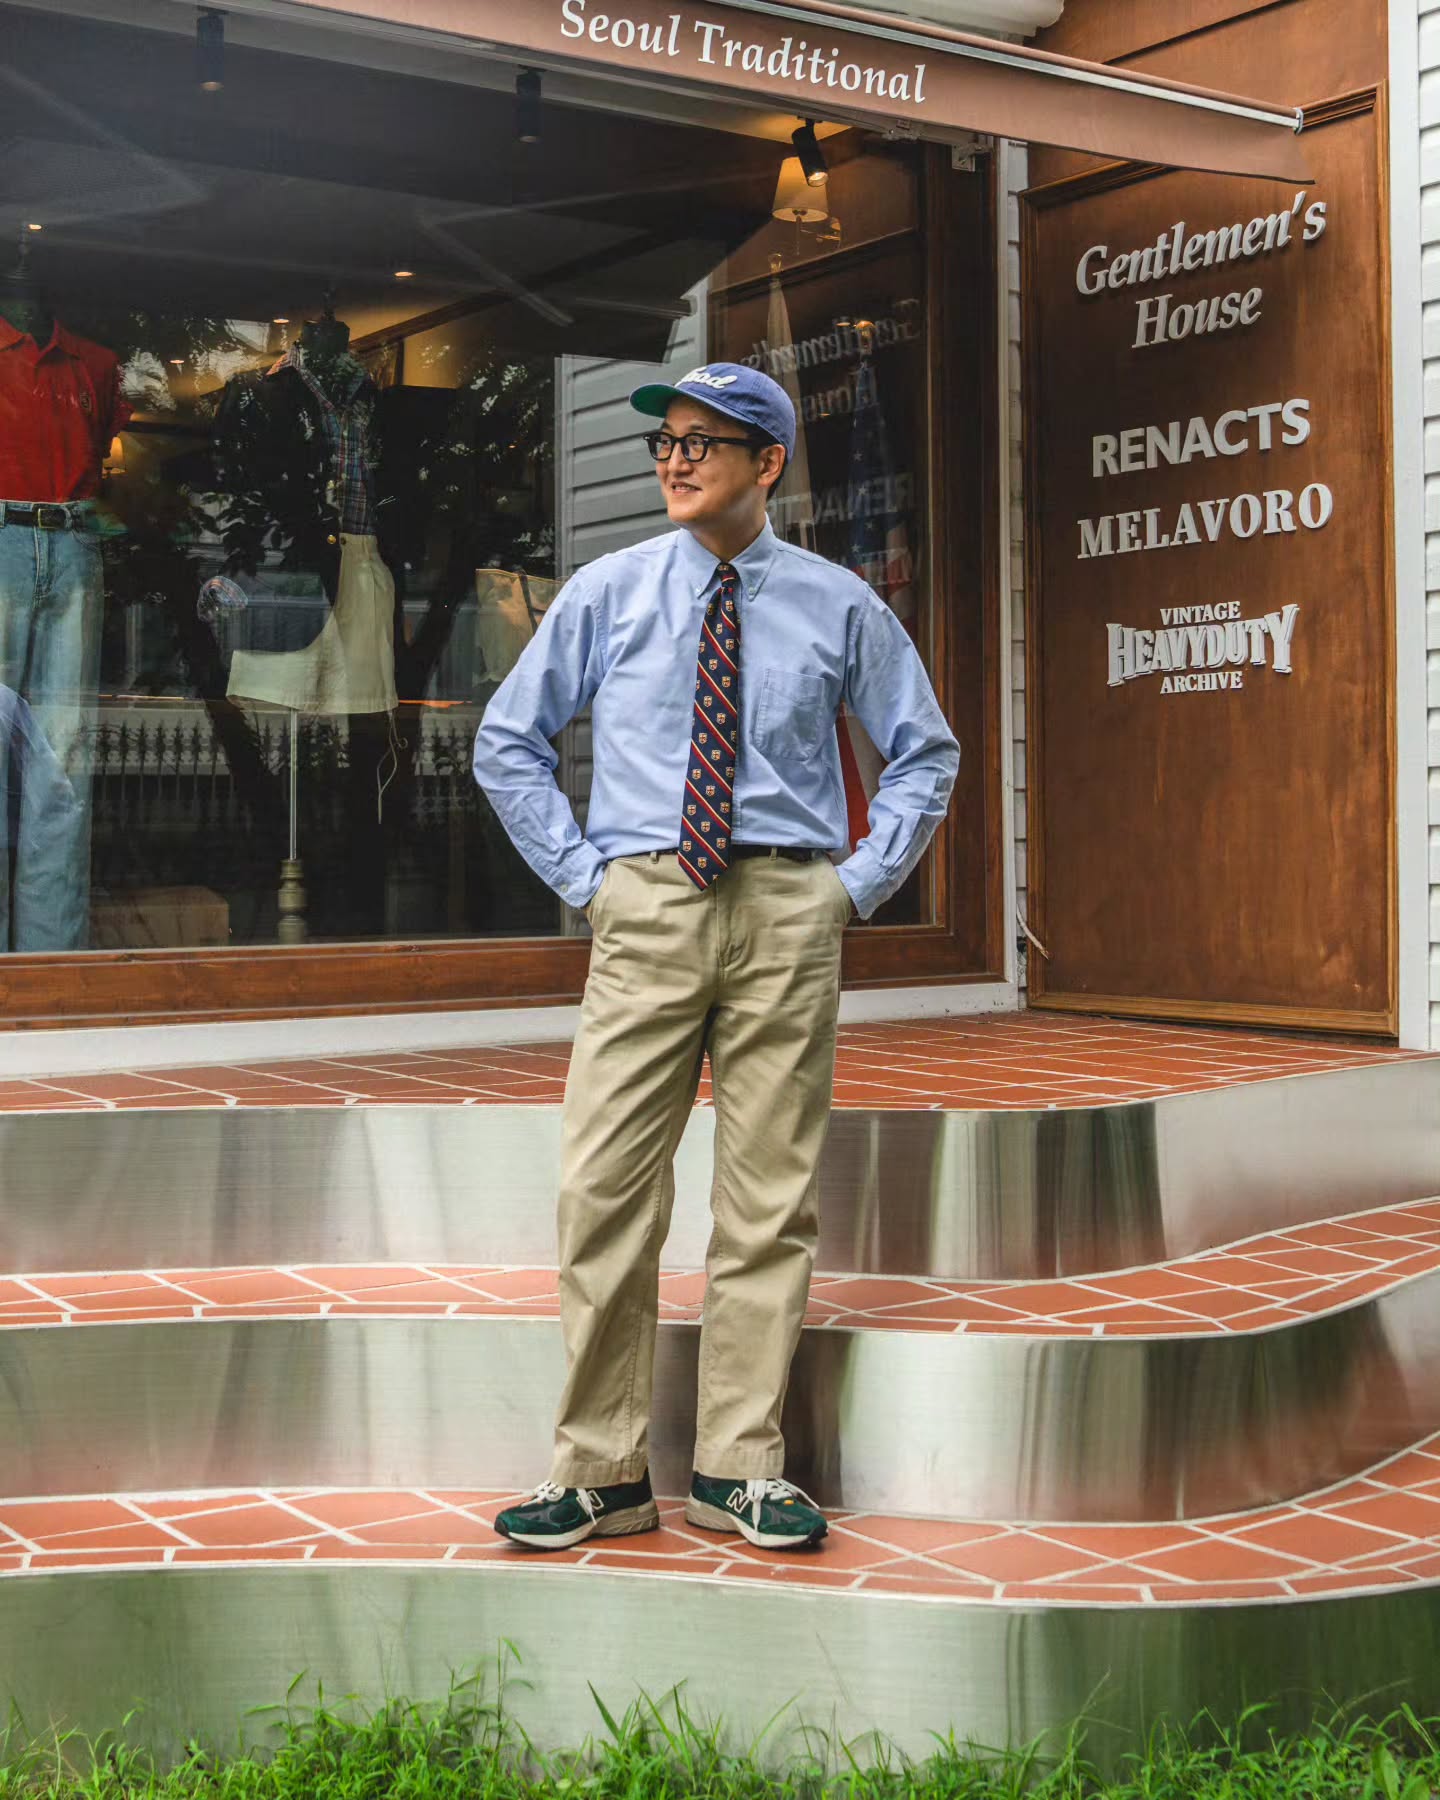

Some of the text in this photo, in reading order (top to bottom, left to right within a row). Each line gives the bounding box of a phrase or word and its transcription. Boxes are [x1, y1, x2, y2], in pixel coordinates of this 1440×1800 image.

[560, 0, 926, 103] Seoul Traditional
[1076, 191, 1327, 295] Gentlemen's
[1132, 288, 1262, 348] House
[1092, 398, 1310, 477] RENACTS
[1077, 483, 1333, 559] MELAVORO
[1106, 604, 1299, 687] HEAVYDUTY
[1160, 601, 1241, 625] VINTAGE
[1160, 671, 1243, 694] ARCHIVE
